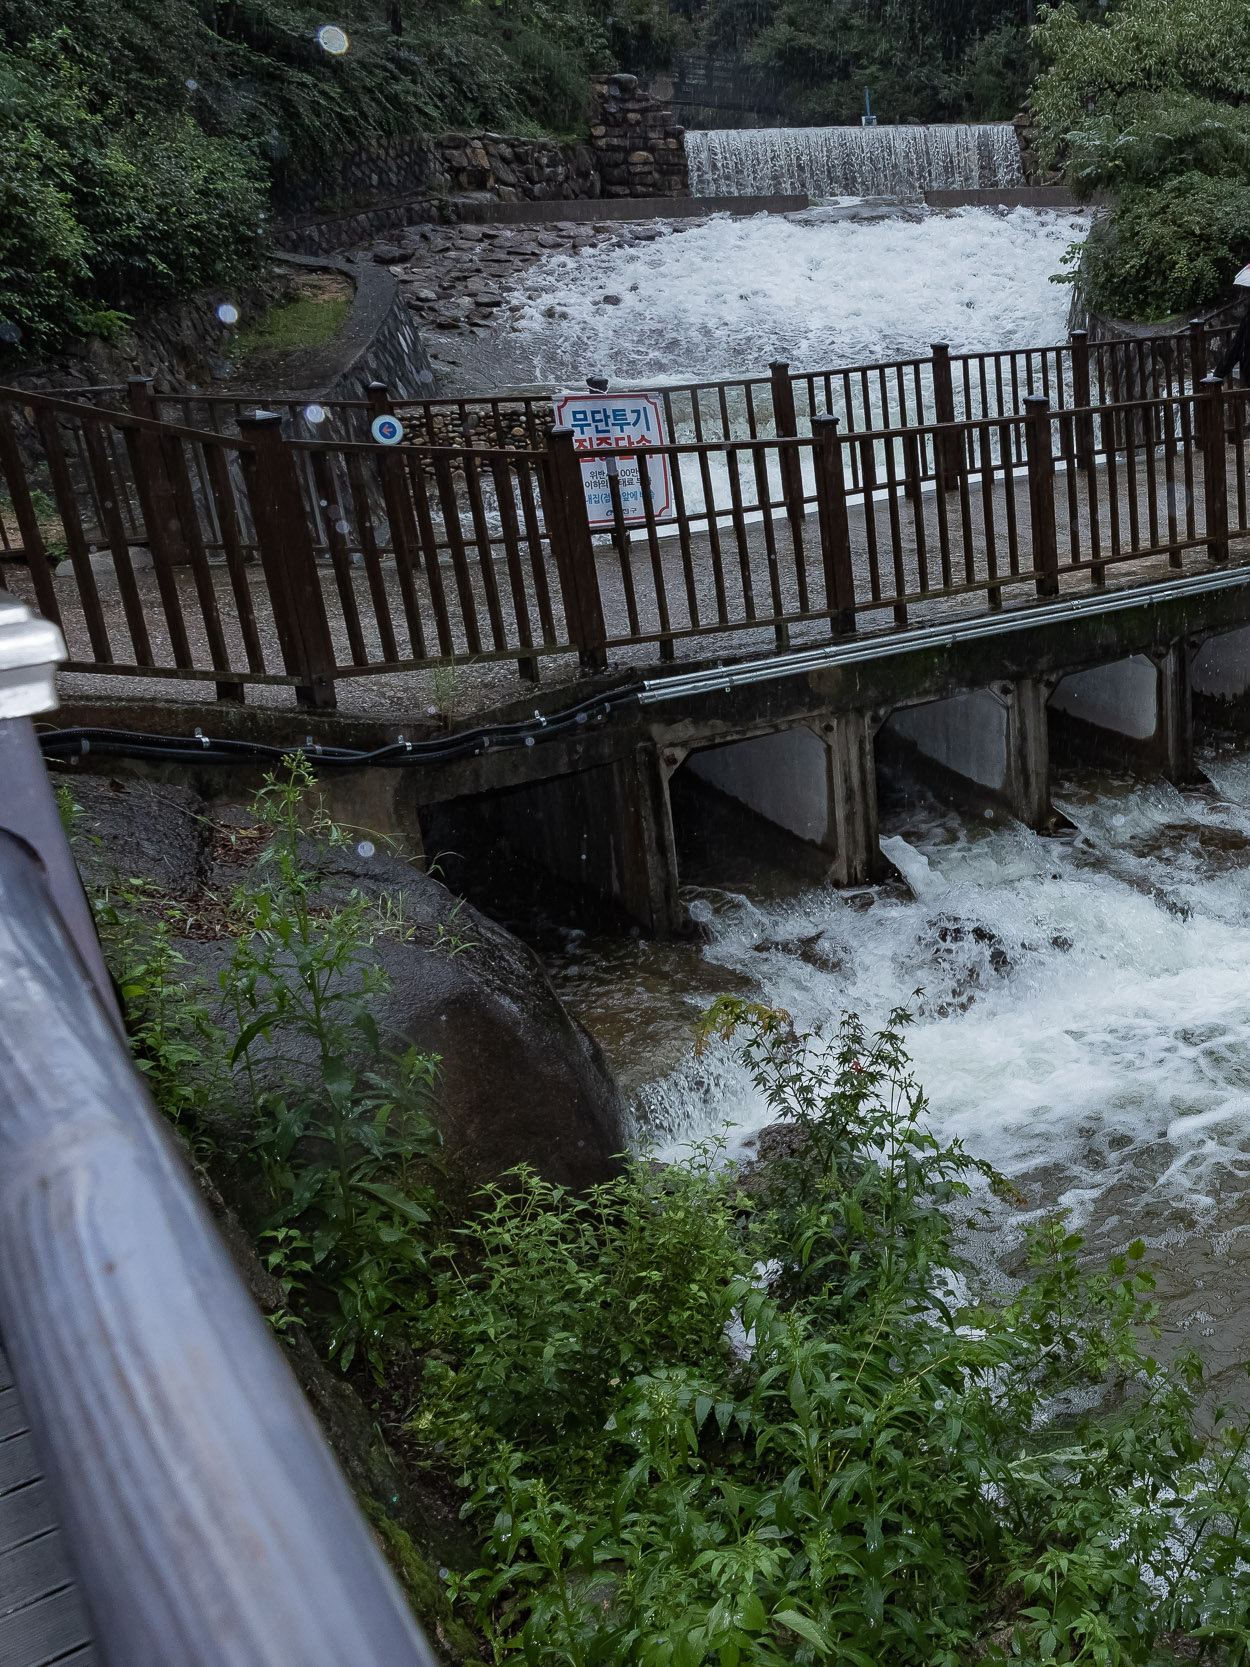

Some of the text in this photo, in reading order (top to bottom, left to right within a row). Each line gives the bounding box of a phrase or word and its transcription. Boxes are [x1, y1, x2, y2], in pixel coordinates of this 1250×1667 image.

[571, 406, 651, 435] 무단투기
[589, 470, 609, 480] 위반
[584, 479, 609, 489] 이하의
[618, 477, 635, 487] 태료
